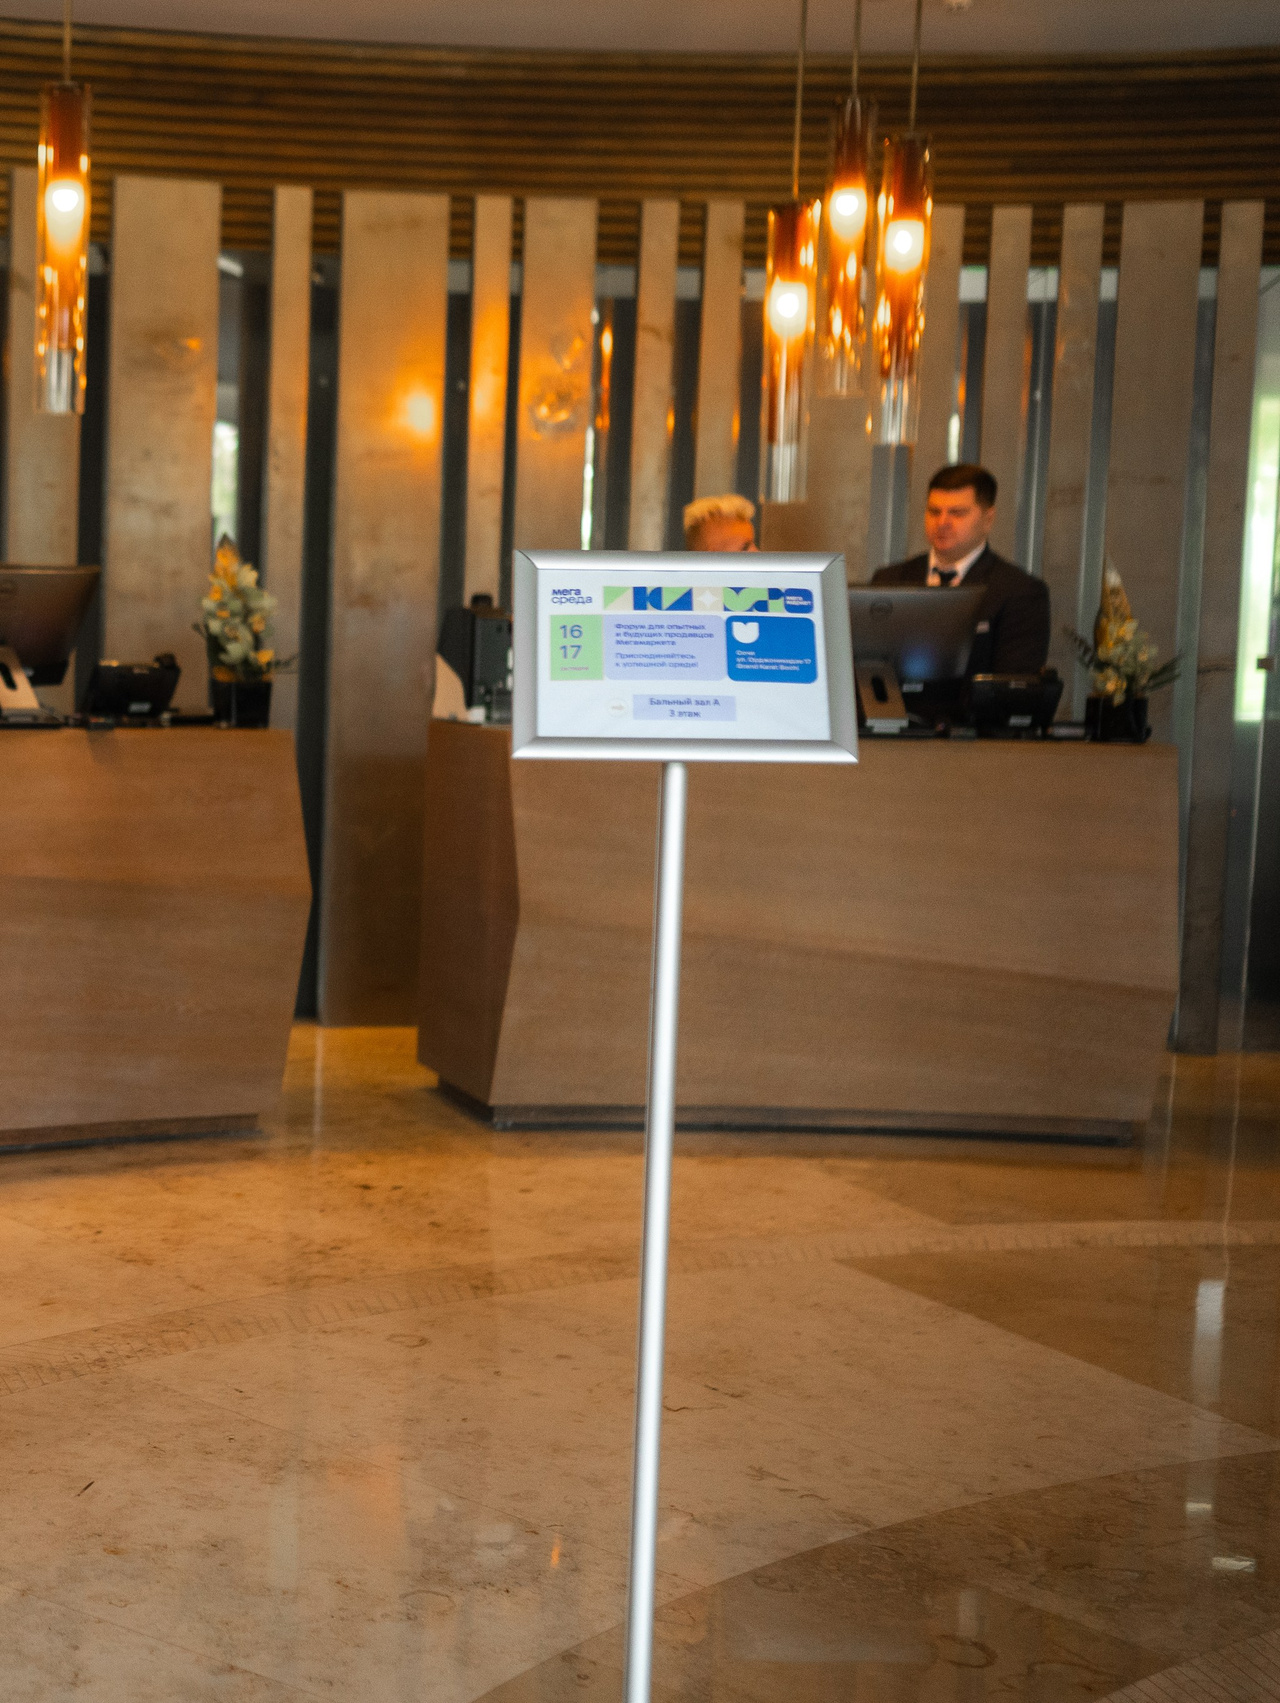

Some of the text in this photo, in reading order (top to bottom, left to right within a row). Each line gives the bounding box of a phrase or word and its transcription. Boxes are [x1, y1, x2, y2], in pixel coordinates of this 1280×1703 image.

[552, 588, 581, 596] мега
[551, 596, 593, 605] среда
[560, 624, 583, 639] 16
[560, 644, 582, 659] 17
[649, 697, 692, 706] Бальный
[677, 710, 701, 718] этаж
